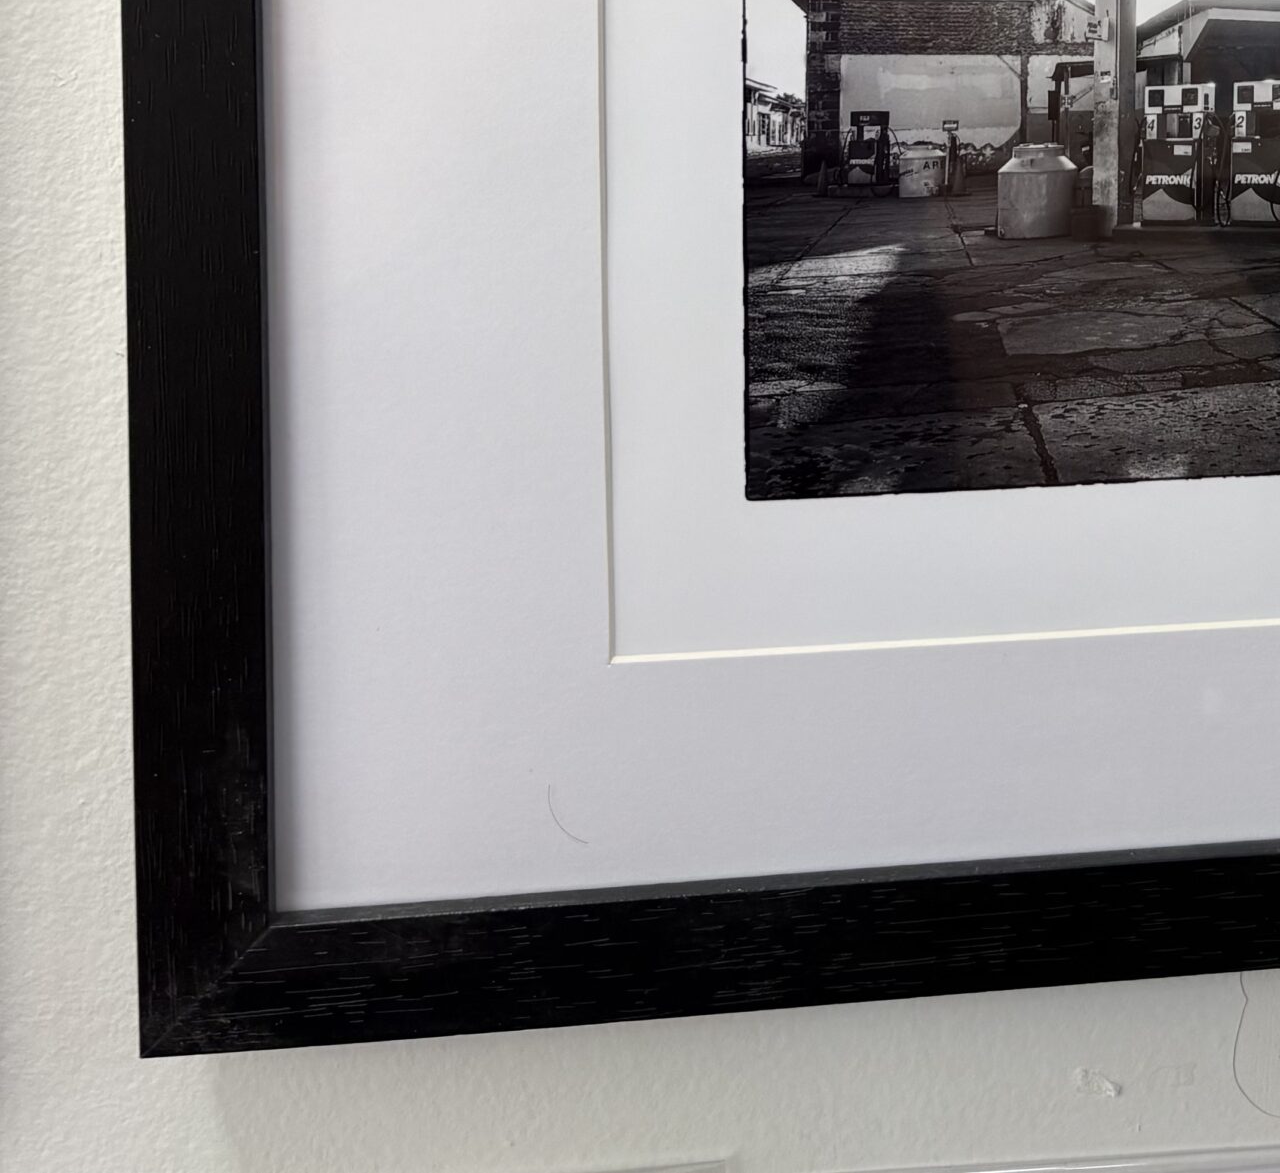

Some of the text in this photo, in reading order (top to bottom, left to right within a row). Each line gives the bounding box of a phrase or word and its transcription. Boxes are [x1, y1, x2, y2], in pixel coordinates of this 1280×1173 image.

[1147, 118, 1155, 131] 4
[1193, 117, 1202, 130] 3
[1236, 115, 1245, 128] 2
